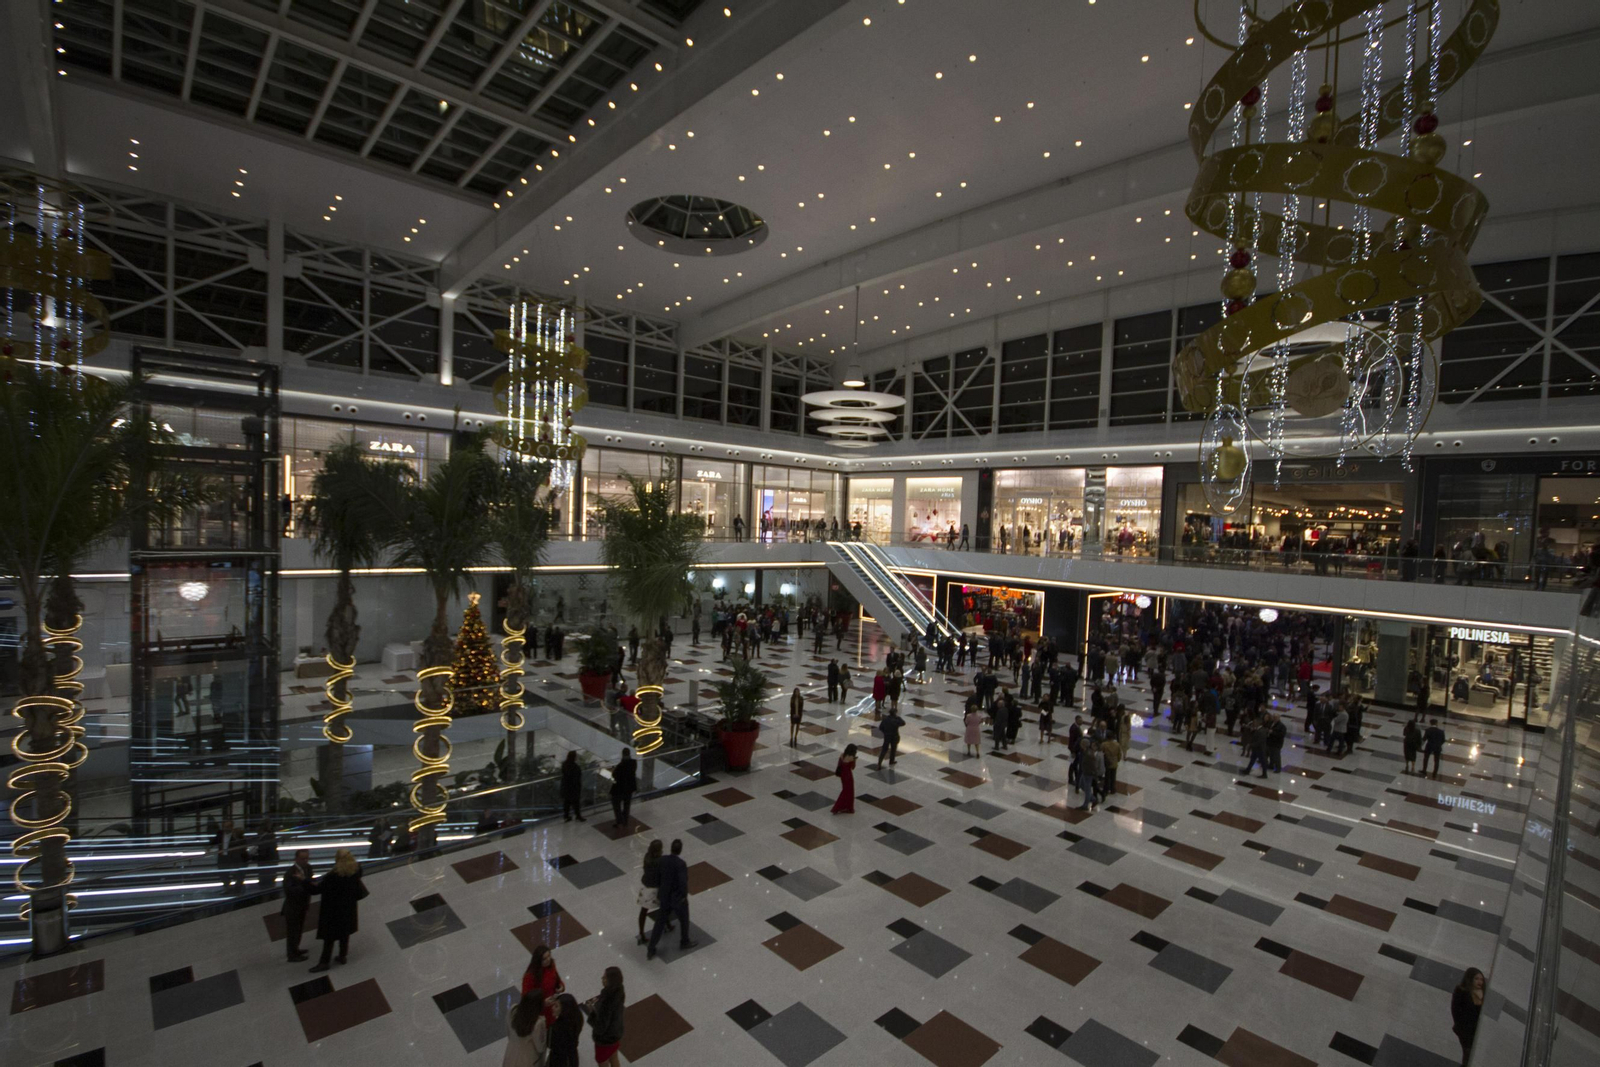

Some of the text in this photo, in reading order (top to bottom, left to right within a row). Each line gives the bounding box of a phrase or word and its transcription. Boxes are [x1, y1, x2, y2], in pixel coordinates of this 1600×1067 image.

[369, 441, 415, 454] ZARA
[1561, 460, 1596, 471] FOR
[696, 470, 722, 479] ZARA
[1020, 497, 1043, 505] OYSHO
[1120, 499, 1147, 507] OYSHO
[1450, 626, 1511, 645] POLINESIA
